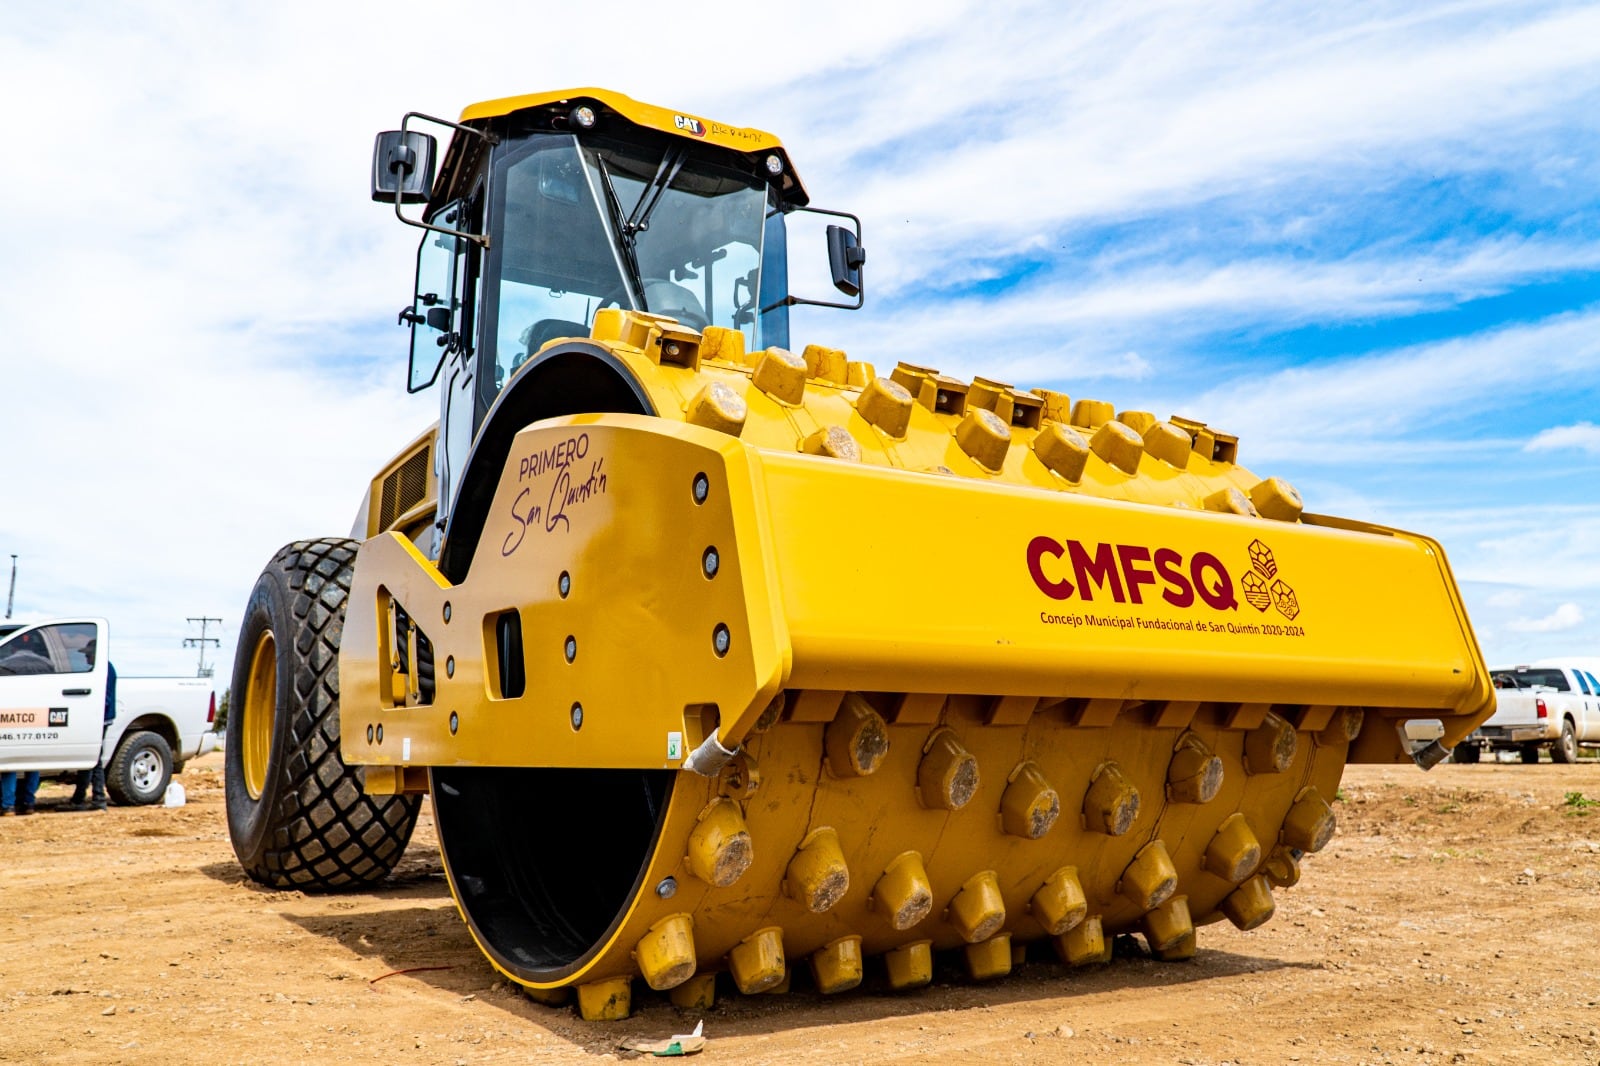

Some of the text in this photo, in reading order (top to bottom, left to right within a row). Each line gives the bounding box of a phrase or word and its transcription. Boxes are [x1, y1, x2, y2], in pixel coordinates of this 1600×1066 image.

[674, 115, 699, 133] CAT
[519, 433, 589, 482] PRIMERO
[502, 457, 607, 557] San Quintín
[1027, 536, 1238, 611] CMFSQ
[1040, 612, 1083, 628] Concejo
[1085, 615, 1135, 630] Municipal
[1136, 617, 1194, 631] Fundacional
[1196, 620, 1207, 632] de
[1209, 621, 1226, 633] San
[1261, 625, 1305, 637] 2020-2024
[0, 713, 35, 723] MATCO
[50, 712, 67, 723] CAT
[0, 732, 59, 740] 46.177.0120
